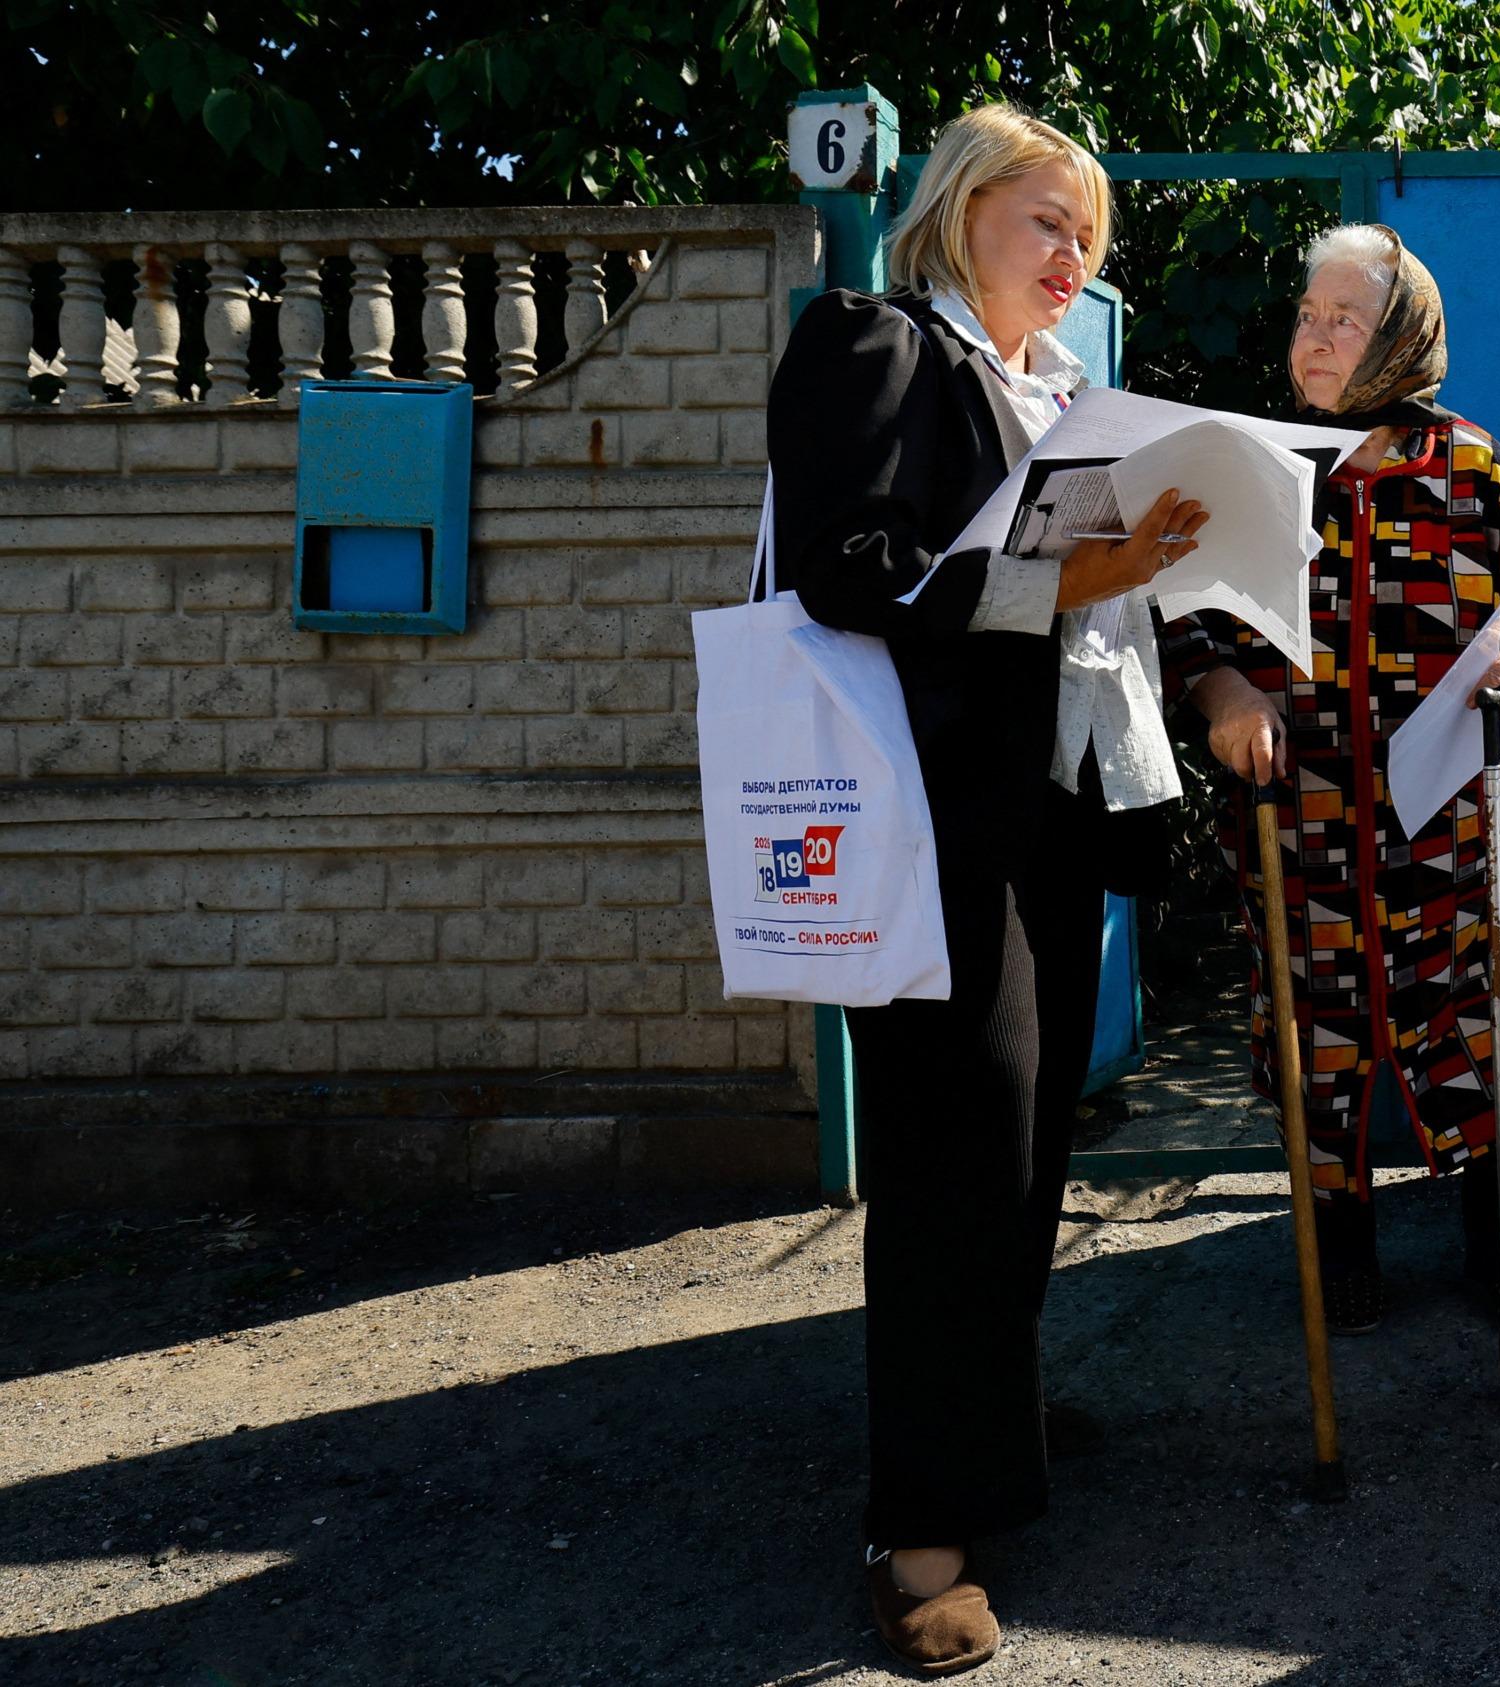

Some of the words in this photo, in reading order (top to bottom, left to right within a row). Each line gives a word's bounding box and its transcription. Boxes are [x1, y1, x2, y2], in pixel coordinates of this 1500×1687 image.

[817, 119, 846, 174] 6
[742, 781, 775, 794] ВЫБОРЫ
[778, 778, 857, 794] ДЕПУТАТОВ
[741, 801, 817, 815] ГОСУДАРСТВЕННОЙ
[818, 802, 861, 814] ДУМЫ
[759, 866, 775, 892] 18
[776, 851, 803, 878] 19
[805, 837, 832, 864] 20
[734, 926, 758, 940] ТВОЙ
[758, 929, 786, 943] ГОЛОС
[798, 931, 823, 945] СИЛА
[824, 930, 879, 945] РОССИИ!
